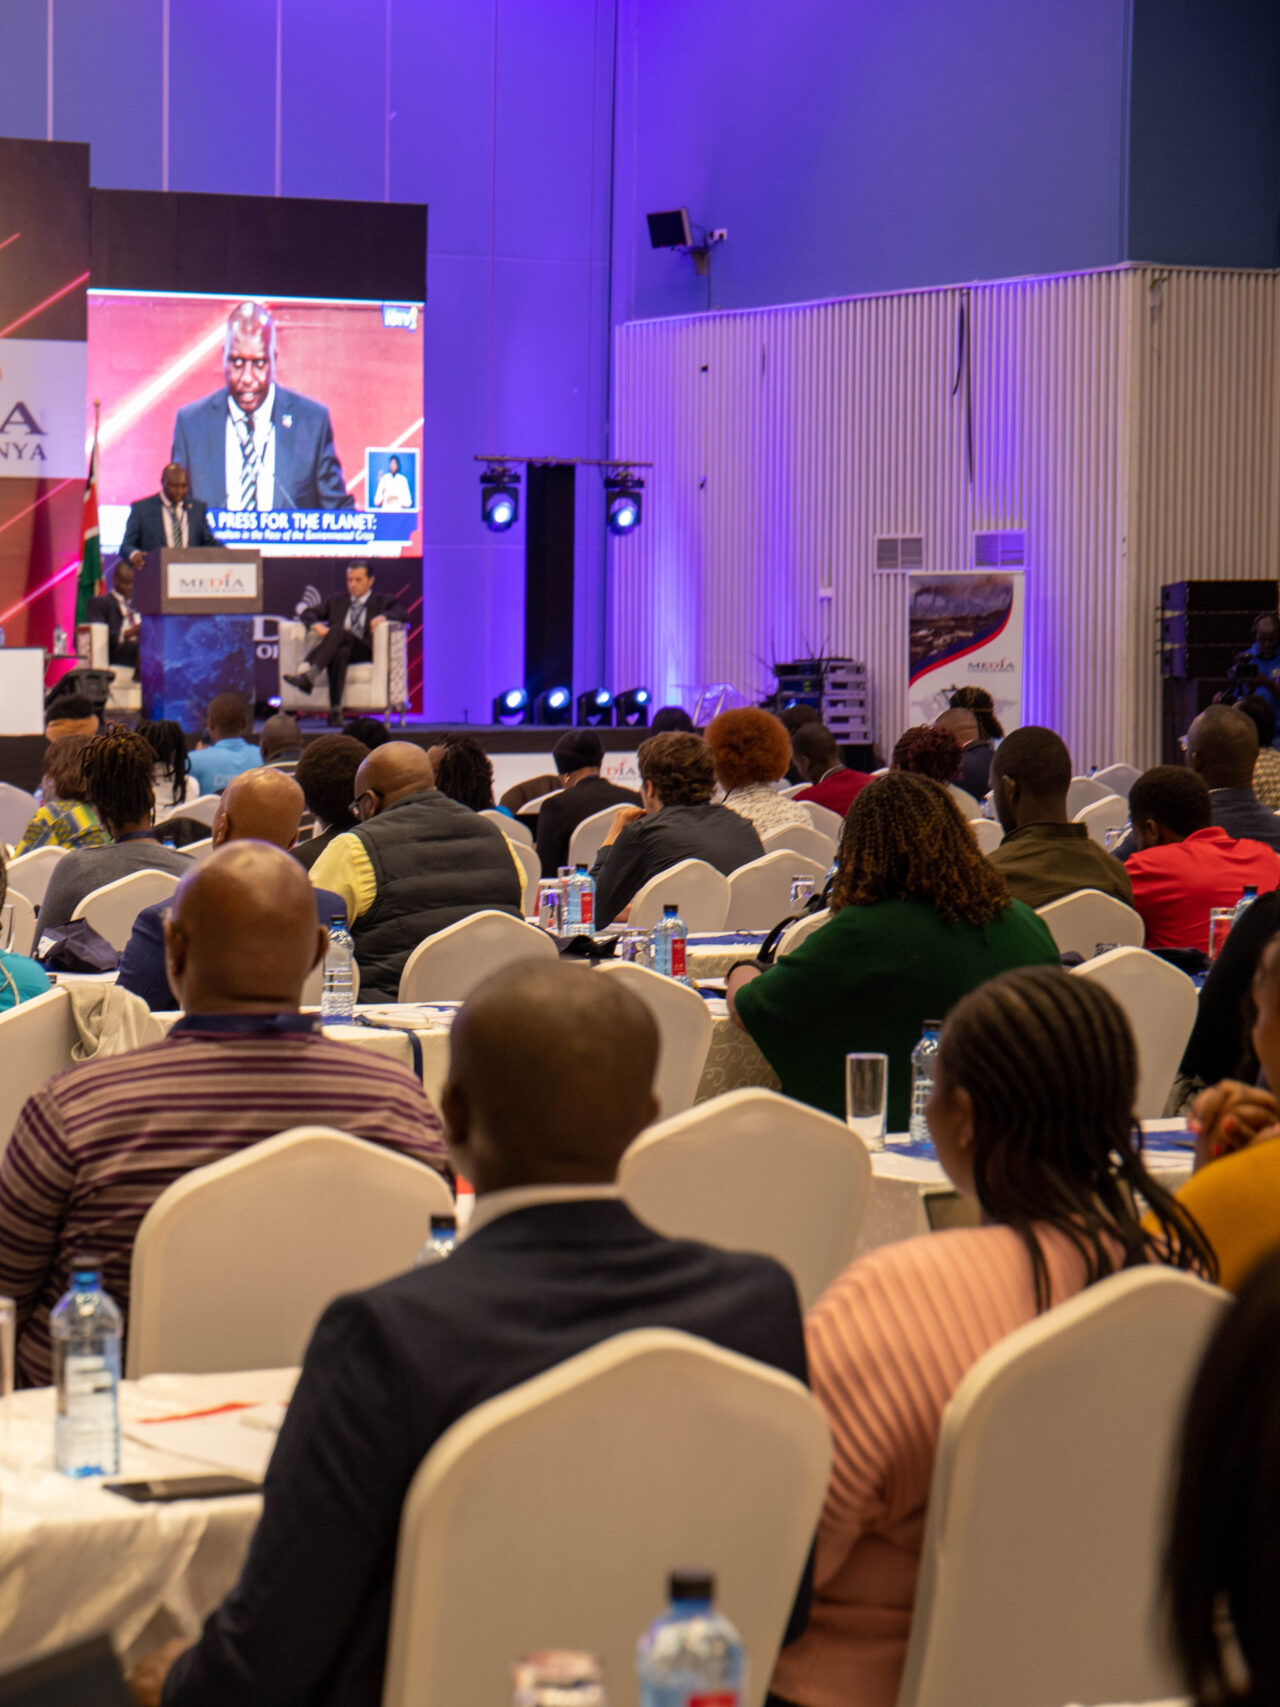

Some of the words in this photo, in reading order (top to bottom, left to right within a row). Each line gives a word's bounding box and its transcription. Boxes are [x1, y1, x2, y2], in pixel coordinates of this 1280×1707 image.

[219, 512, 258, 530] PRESS
[260, 512, 290, 530] FOR
[292, 513, 320, 531] THE
